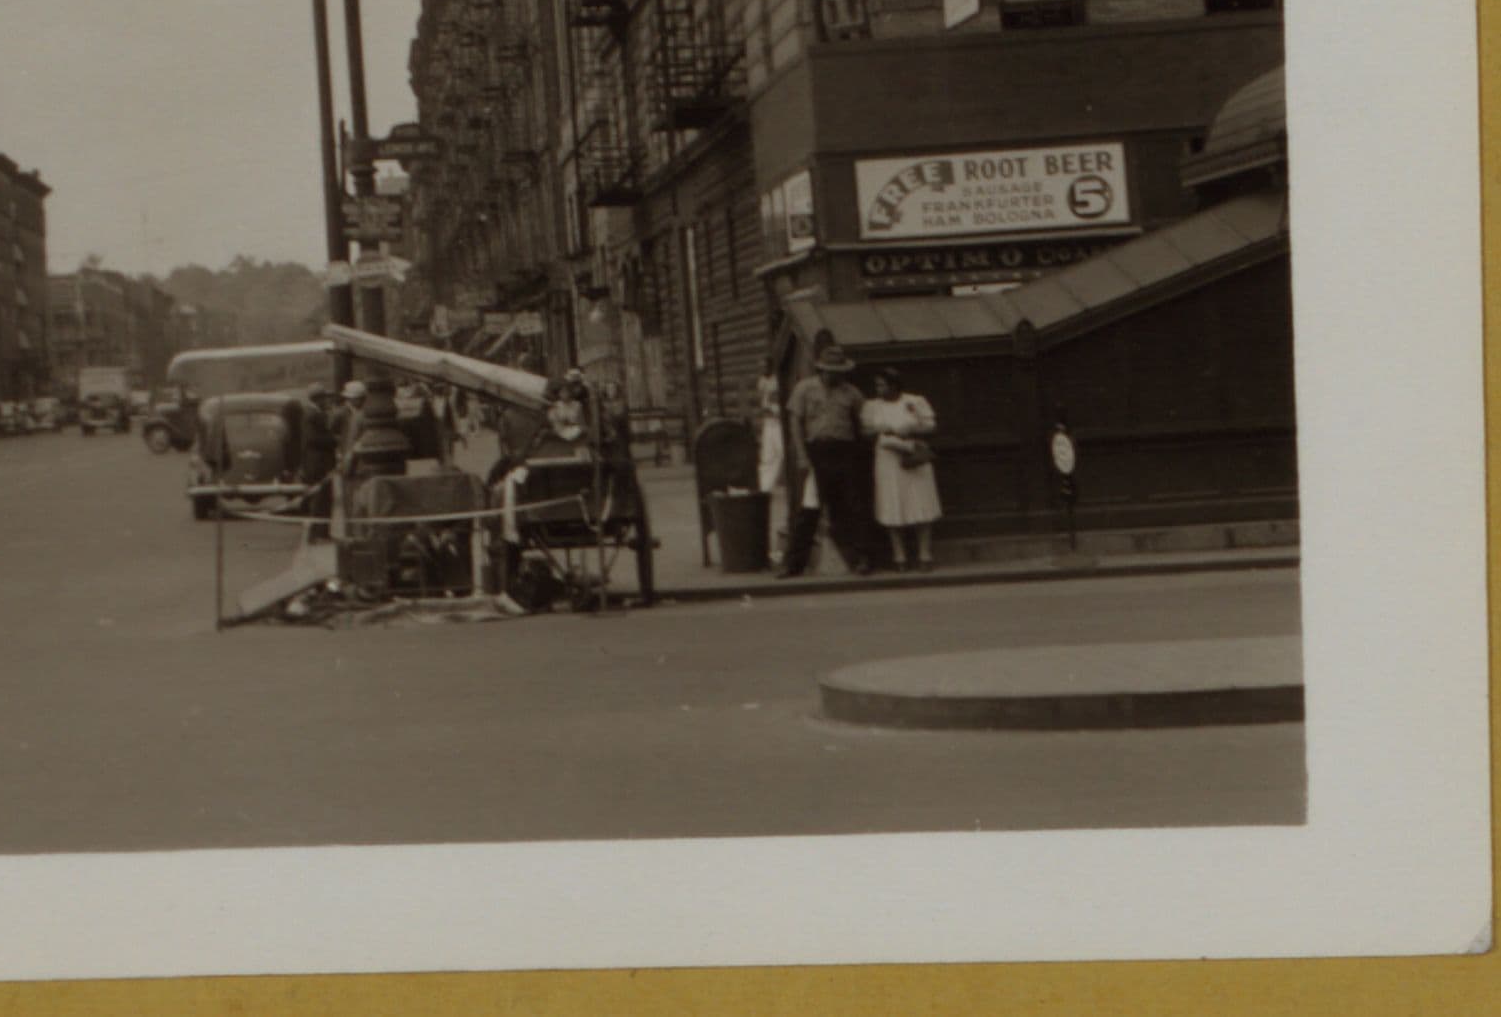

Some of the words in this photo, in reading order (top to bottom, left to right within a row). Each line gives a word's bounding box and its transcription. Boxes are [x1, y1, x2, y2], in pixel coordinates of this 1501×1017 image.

[964, 157, 1028, 181] ROOT
[1044, 151, 1114, 175] BEER
[870, 161, 942, 224] FREE
[962, 181, 1043, 197] SAUSAGE
[921, 194, 1054, 212] FRANKFURTER
[922, 214, 962, 227] HAM
[973, 209, 1055, 225] BOLOGNA
[865, 247, 1022, 274] OPTIMO
